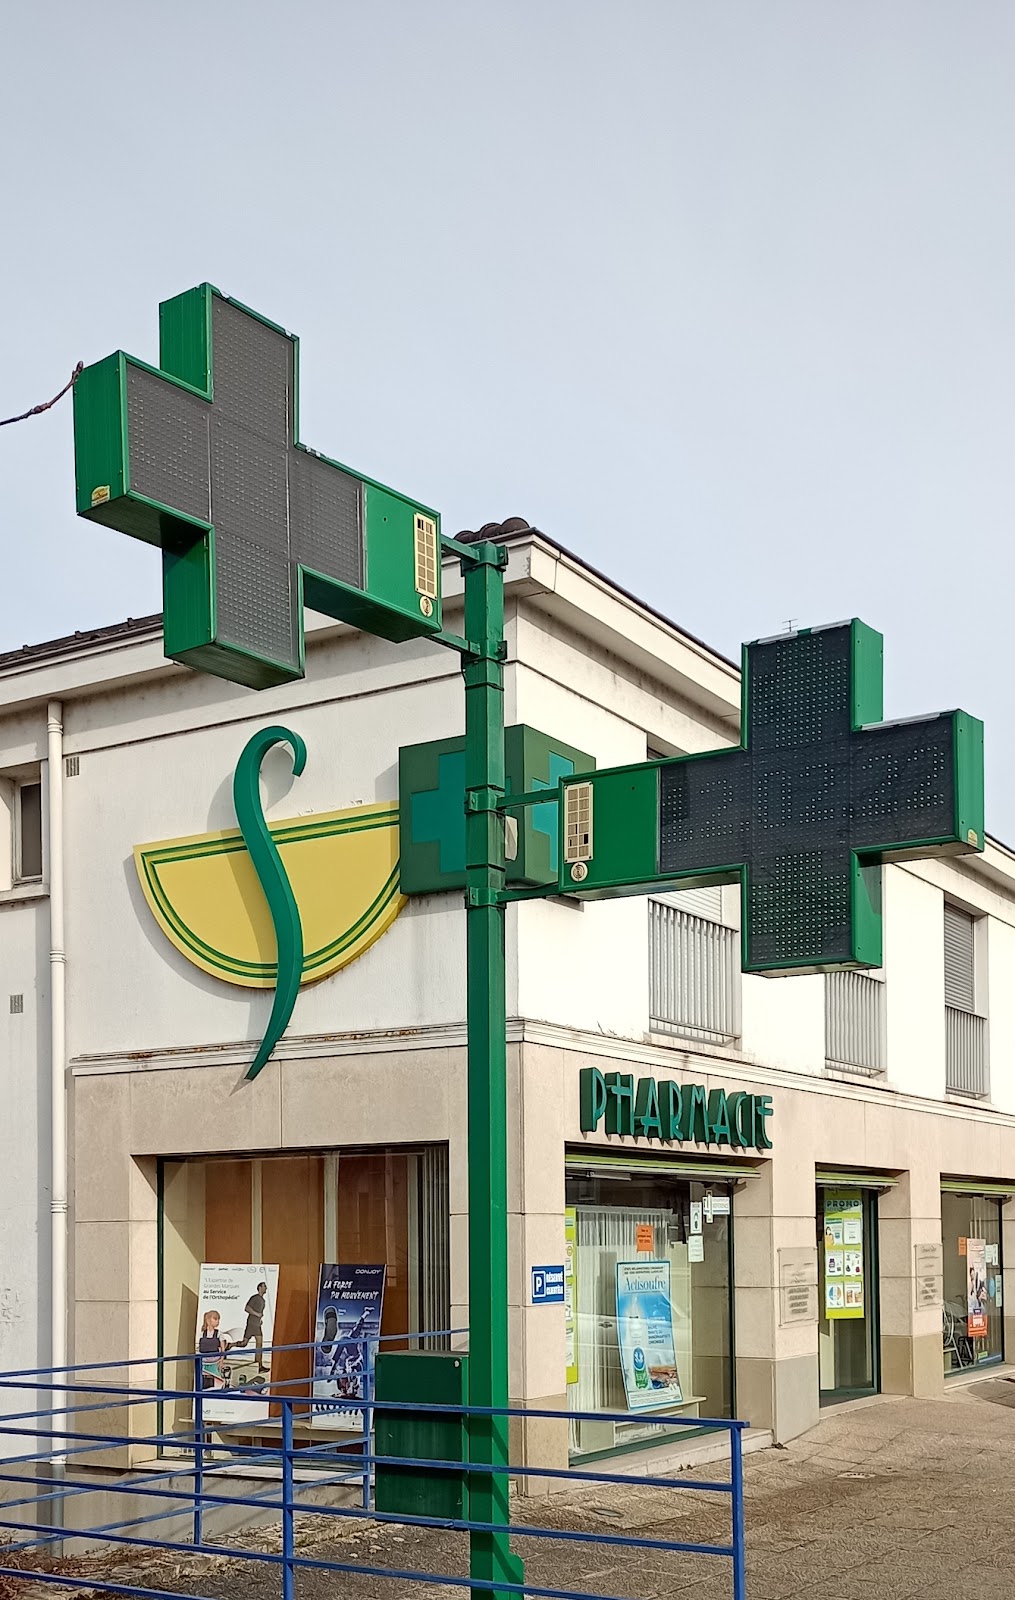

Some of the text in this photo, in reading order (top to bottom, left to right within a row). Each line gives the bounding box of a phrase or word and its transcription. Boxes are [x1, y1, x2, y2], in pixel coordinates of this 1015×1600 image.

[661, 746, 945, 845] 12.02.22
[580, 1066, 774, 1149] PHARMACIE
[826, 1200, 860, 1208] PROMO
[323, 1280, 353, 1290] LA FORCE
[535, 1276, 543, 1293] P
[624, 1274, 666, 1291] Actisoufre
